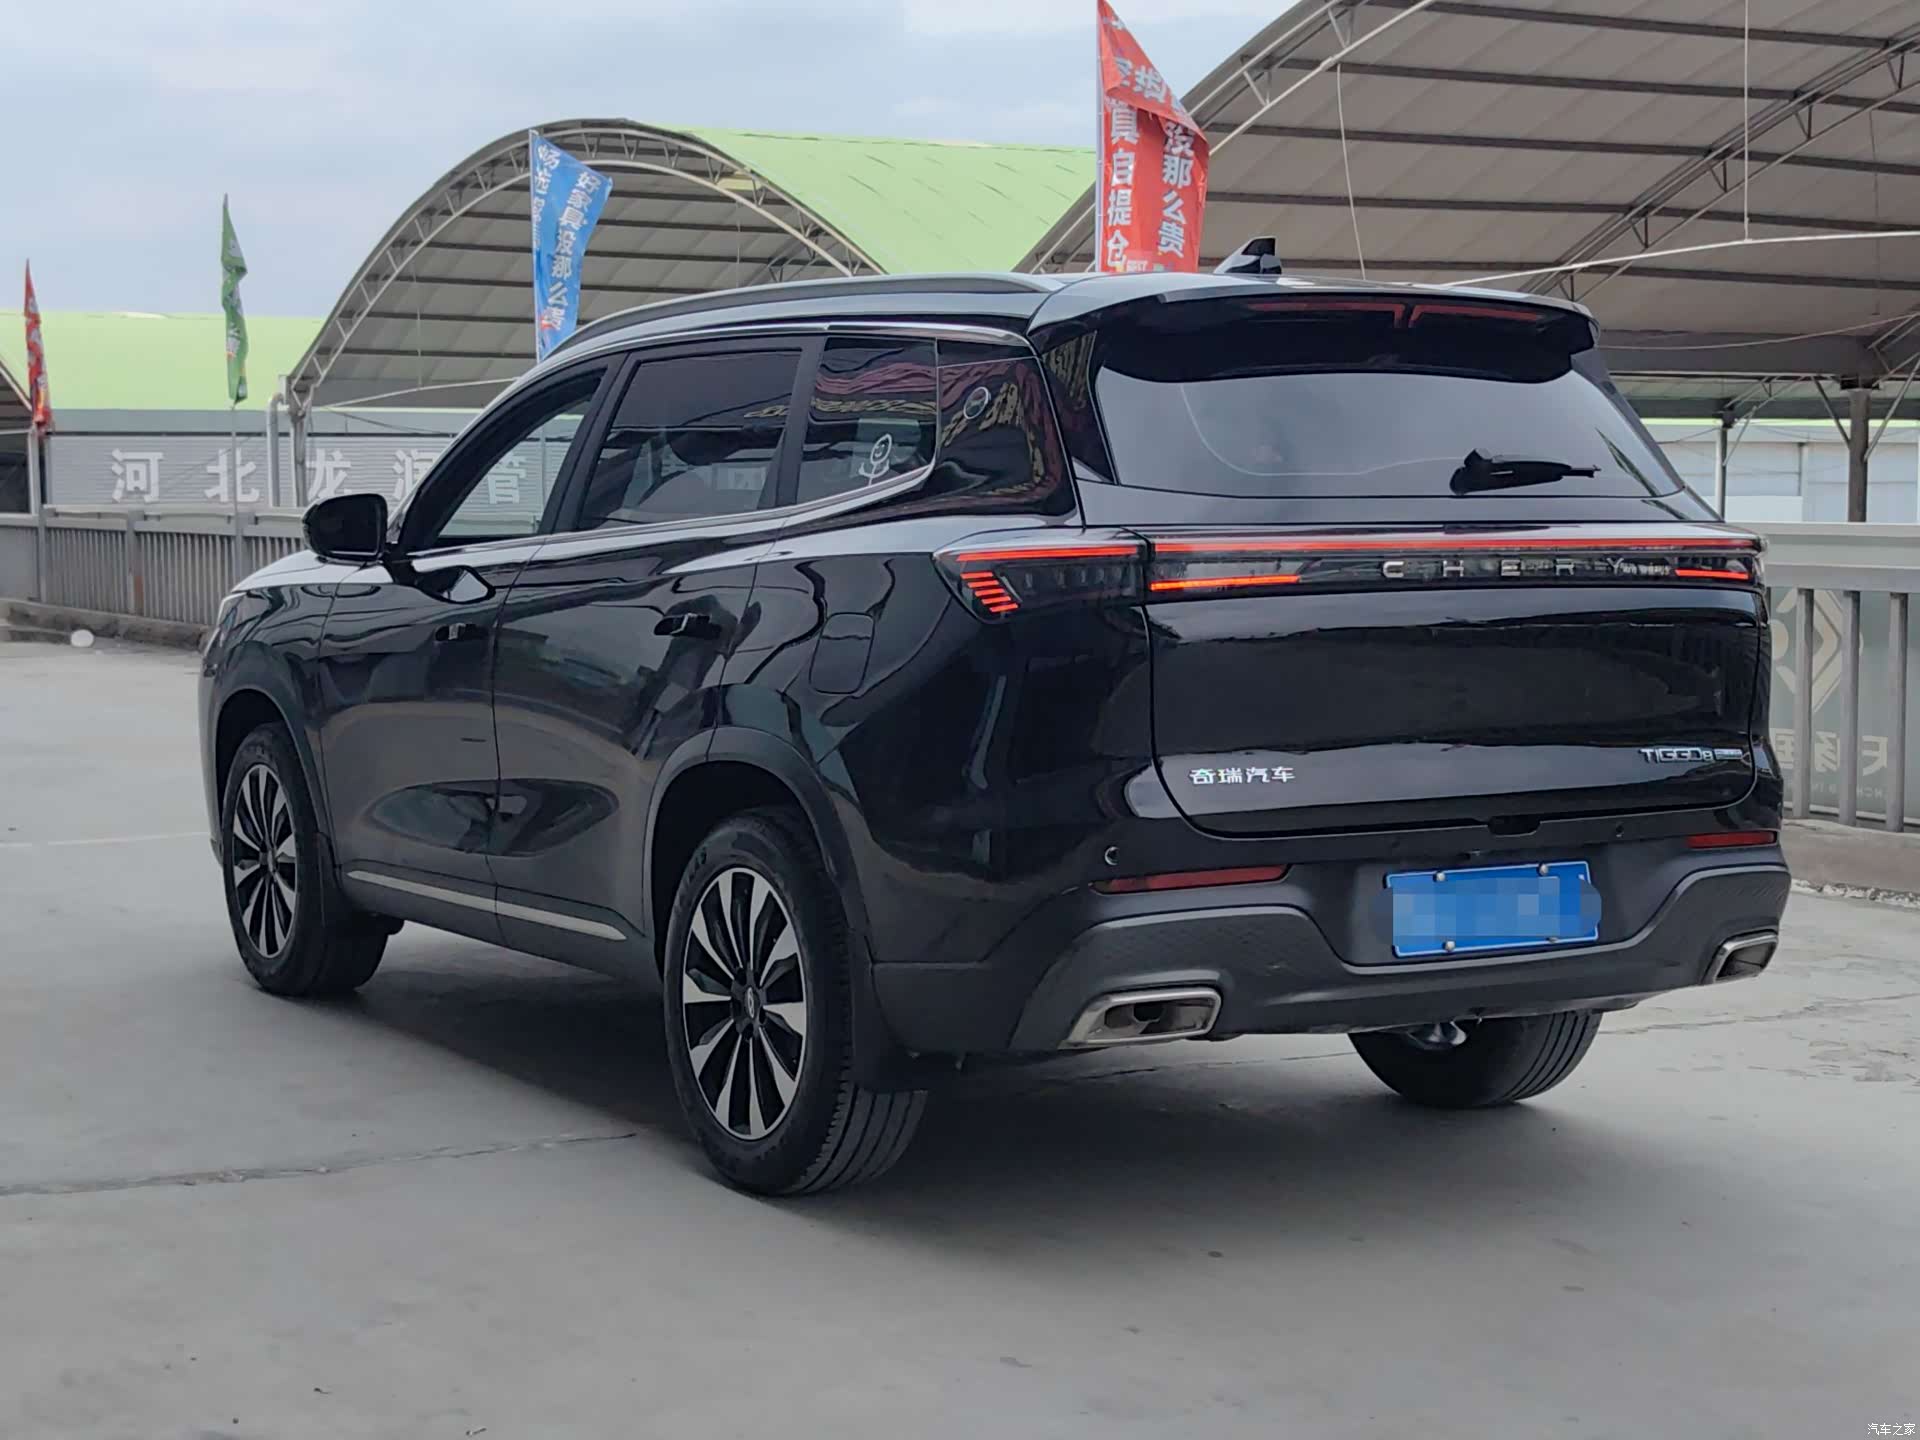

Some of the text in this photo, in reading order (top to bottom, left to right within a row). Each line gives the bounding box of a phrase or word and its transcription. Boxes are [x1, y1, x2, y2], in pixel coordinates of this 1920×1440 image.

[1382, 557, 1625, 579] CHERY
[1189, 766, 1295, 785] 奇瑞汽车
